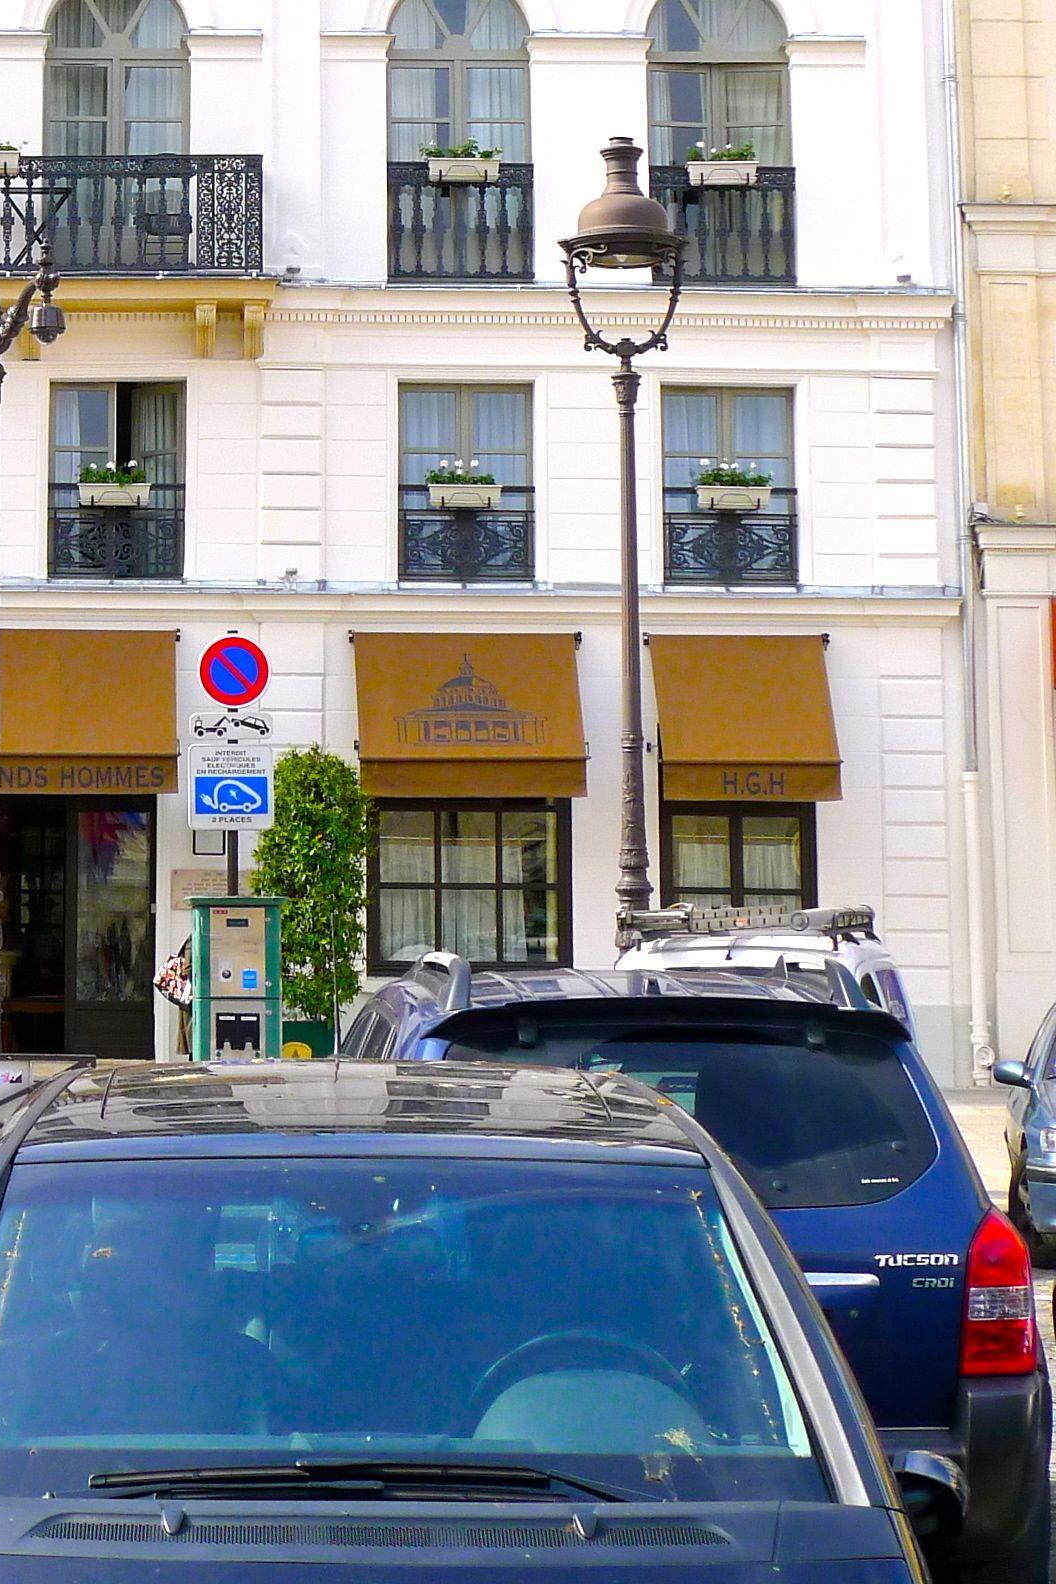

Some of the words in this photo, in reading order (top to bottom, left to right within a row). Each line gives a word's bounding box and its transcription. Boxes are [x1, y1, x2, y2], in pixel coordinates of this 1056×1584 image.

[60, 767, 165, 789] HOMMES
[723, 771, 785, 795] H.G.H
[874, 1254, 959, 1267] TUCSON
